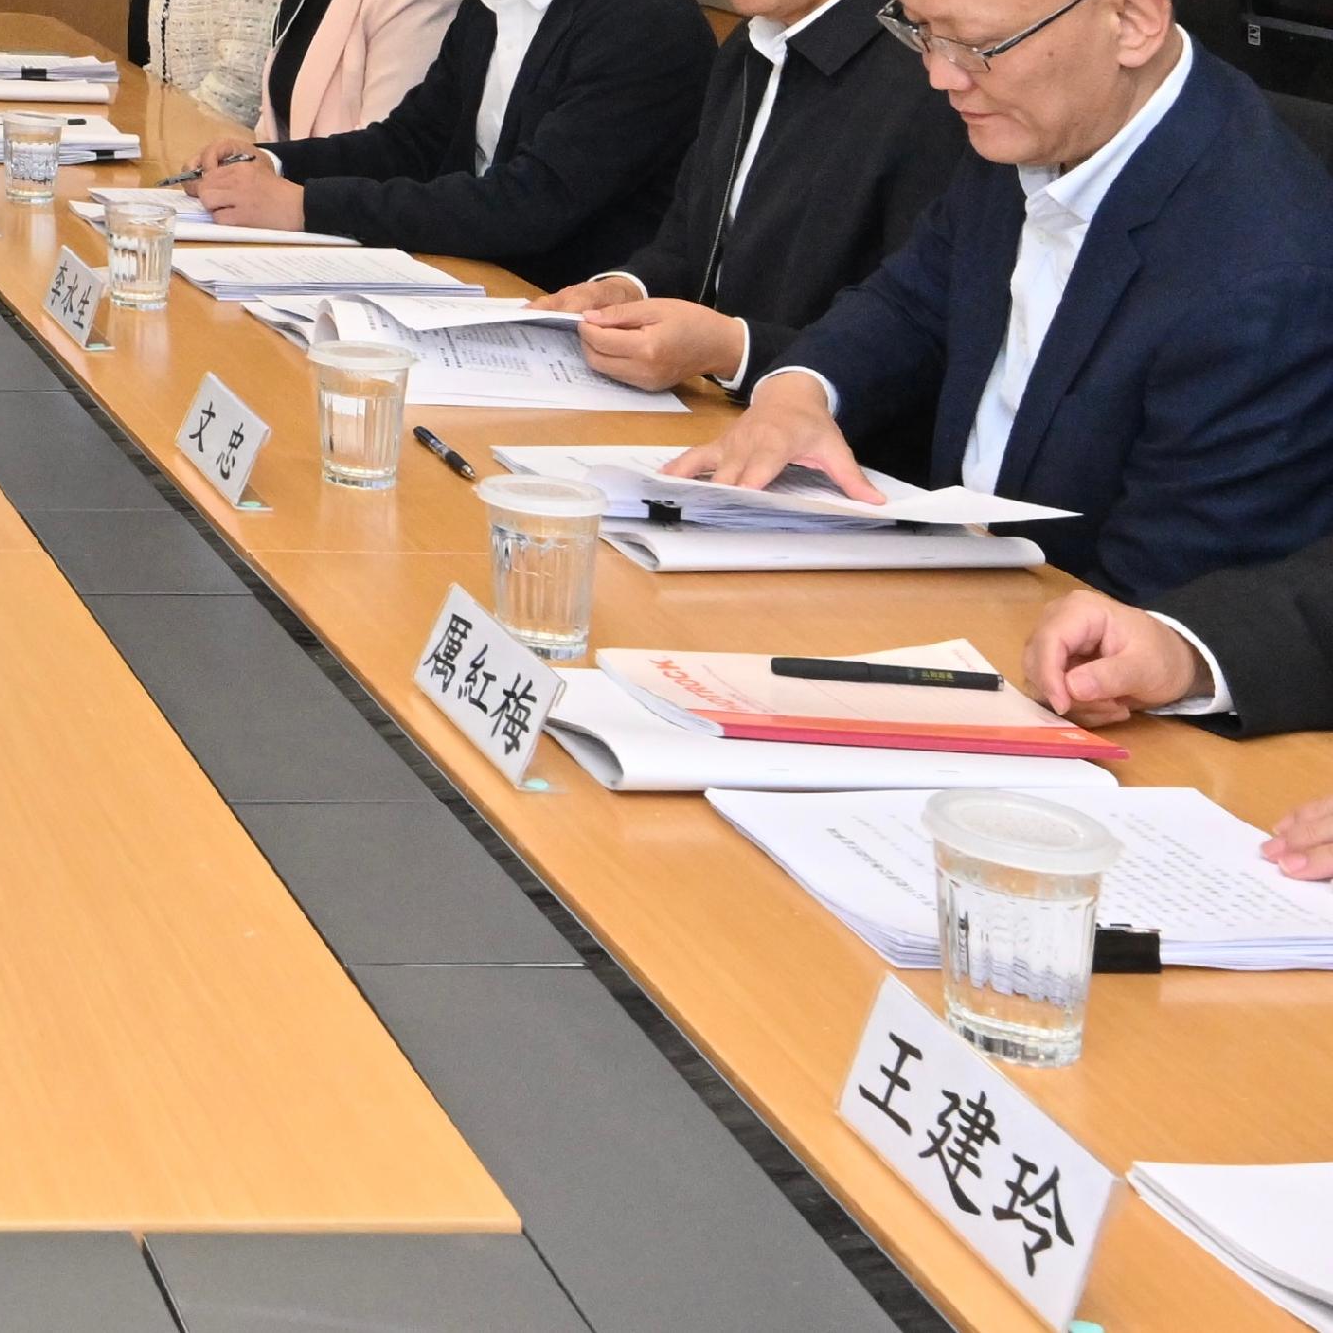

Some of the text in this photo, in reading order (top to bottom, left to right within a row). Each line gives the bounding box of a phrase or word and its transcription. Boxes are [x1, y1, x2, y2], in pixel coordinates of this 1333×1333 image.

[50, 260, 95, 330] 李水生
[188, 401, 245, 480] 文忠
[422, 613, 538, 756] 厲紅梅
[857, 1031, 1076, 1278] 王建玲
